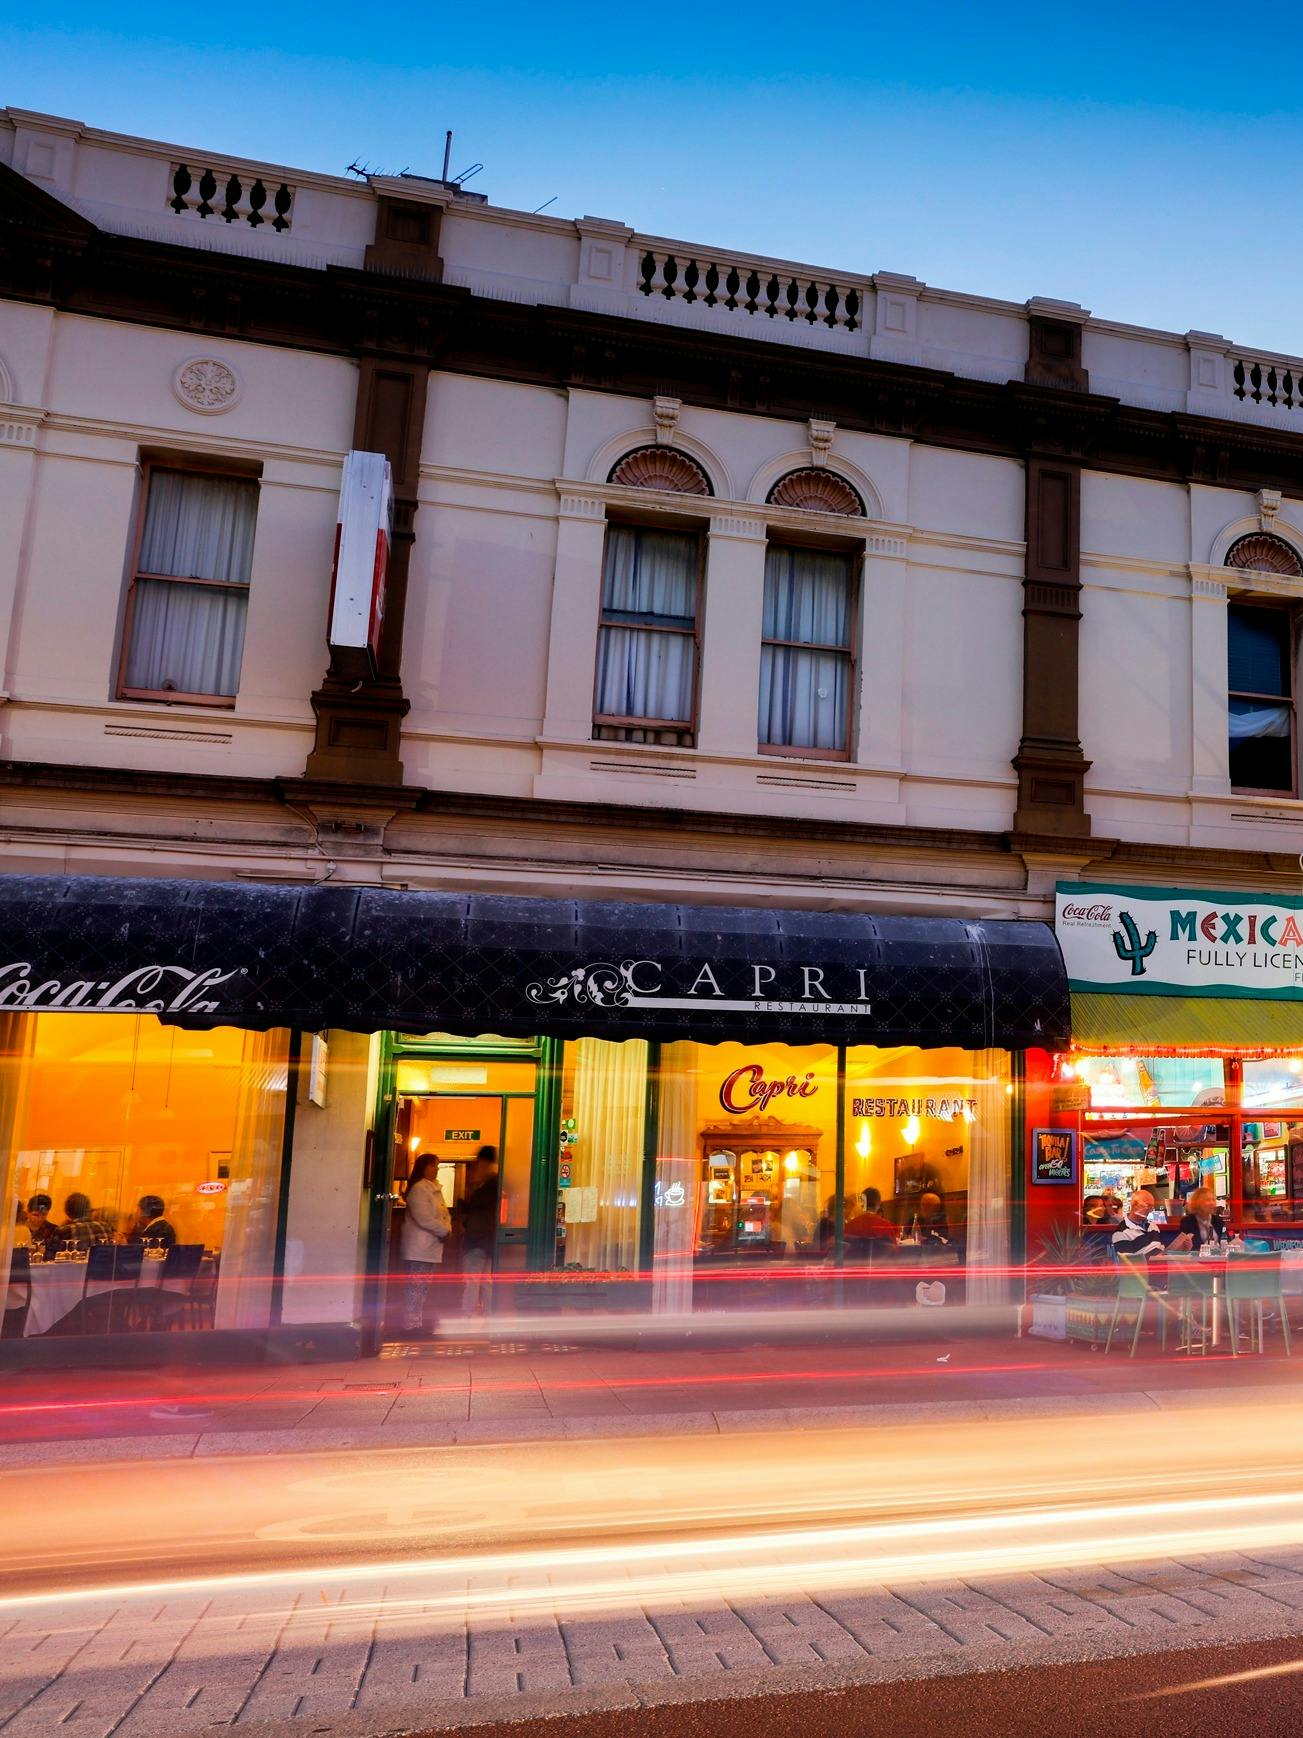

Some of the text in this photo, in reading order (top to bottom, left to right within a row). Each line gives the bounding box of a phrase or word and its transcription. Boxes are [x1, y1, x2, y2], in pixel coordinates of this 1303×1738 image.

[1062, 903, 1113, 921] Coca-Cola
[1186, 949, 1247, 967] FULLY
[627, 960, 870, 1000] CAPRI
[754, 1001, 870, 1014] RESTAURANT
[719, 1064, 819, 1115] Capri
[852, 1097, 978, 1122] RESTAURANT
[451, 1131, 473, 1140] EXIT
